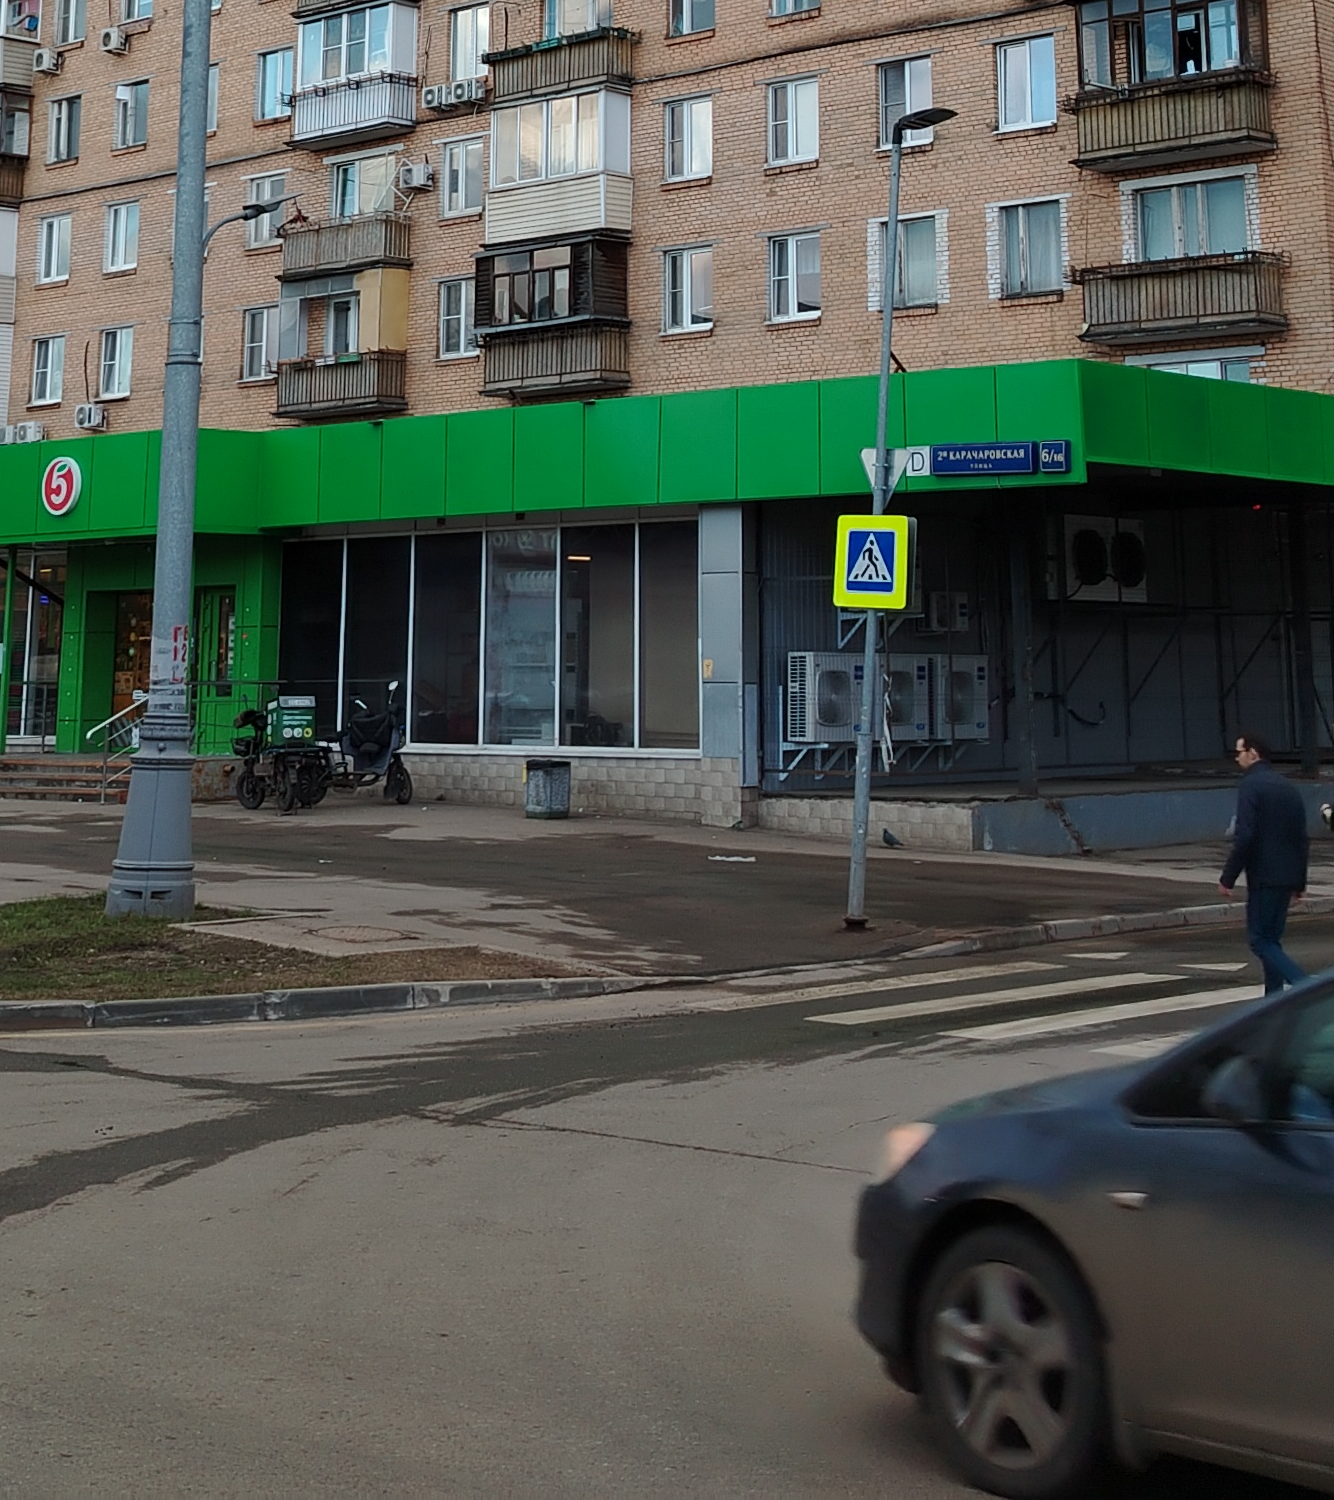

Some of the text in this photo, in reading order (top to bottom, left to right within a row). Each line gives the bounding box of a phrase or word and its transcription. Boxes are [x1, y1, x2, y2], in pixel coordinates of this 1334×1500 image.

[911, 451, 925, 472] D
[949, 448, 1025, 461] КАРАЧАРОВСКАЯ
[1041, 449, 1064, 463] 6/16
